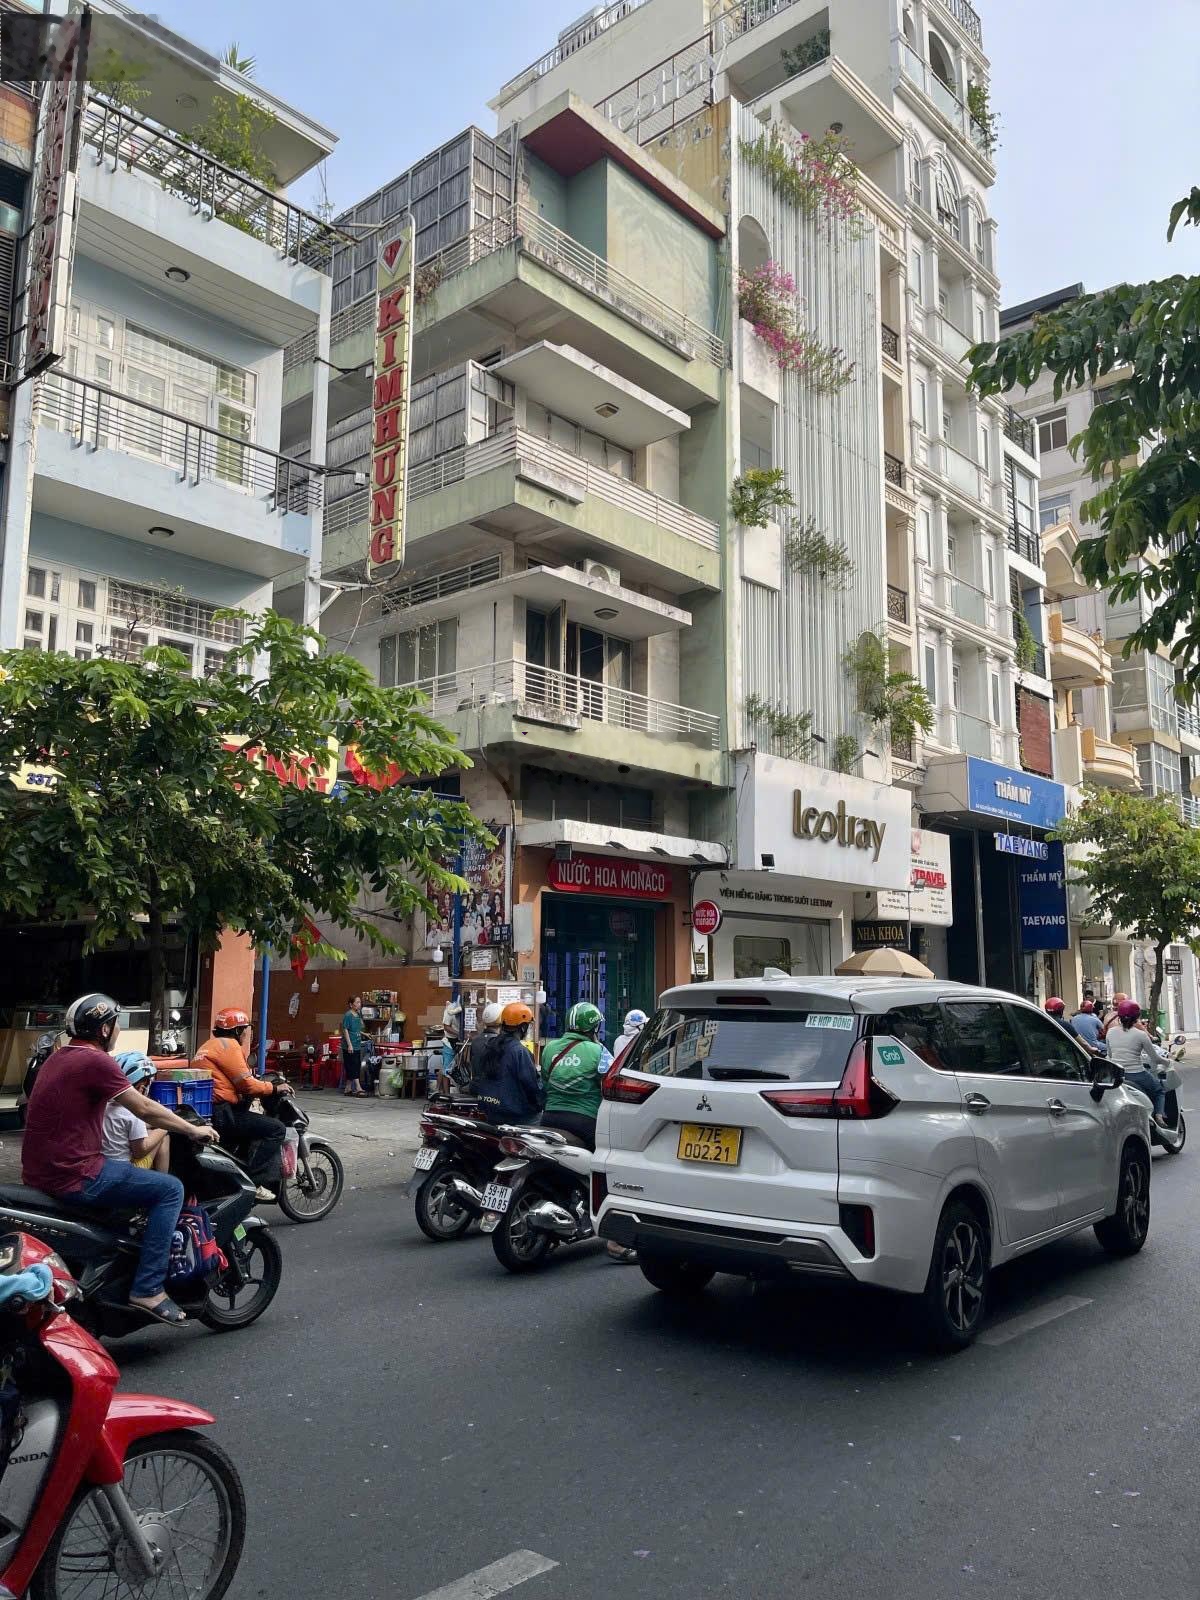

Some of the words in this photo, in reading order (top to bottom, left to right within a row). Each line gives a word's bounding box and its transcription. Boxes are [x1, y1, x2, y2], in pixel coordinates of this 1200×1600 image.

[27, 772, 53, 787] 337
[993, 832, 1049, 861] TAEYANG
[558, 859, 591, 886] NƯỚC
[594, 866, 617, 888] HOA
[621, 869, 665, 893] MONACO
[1021, 868, 1047, 883] THẨM
[1048, 871, 1062, 882] MỸ
[1022, 915, 1066, 926] TAEYANG
[857, 927, 876, 940] NHA
[878, 926, 904, 940] KHOA
[808, 1015, 817, 1026] XE
[882, 1050, 901, 1062] Grab
[699, 1127, 723, 1143] 77E
[684, 1143, 730, 1162] 002.21
[488, 1184, 508, 1198] 59-H1
[481, 1197, 508, 1212] 510.85
[7, 1451, 49, 1465] ONDA
